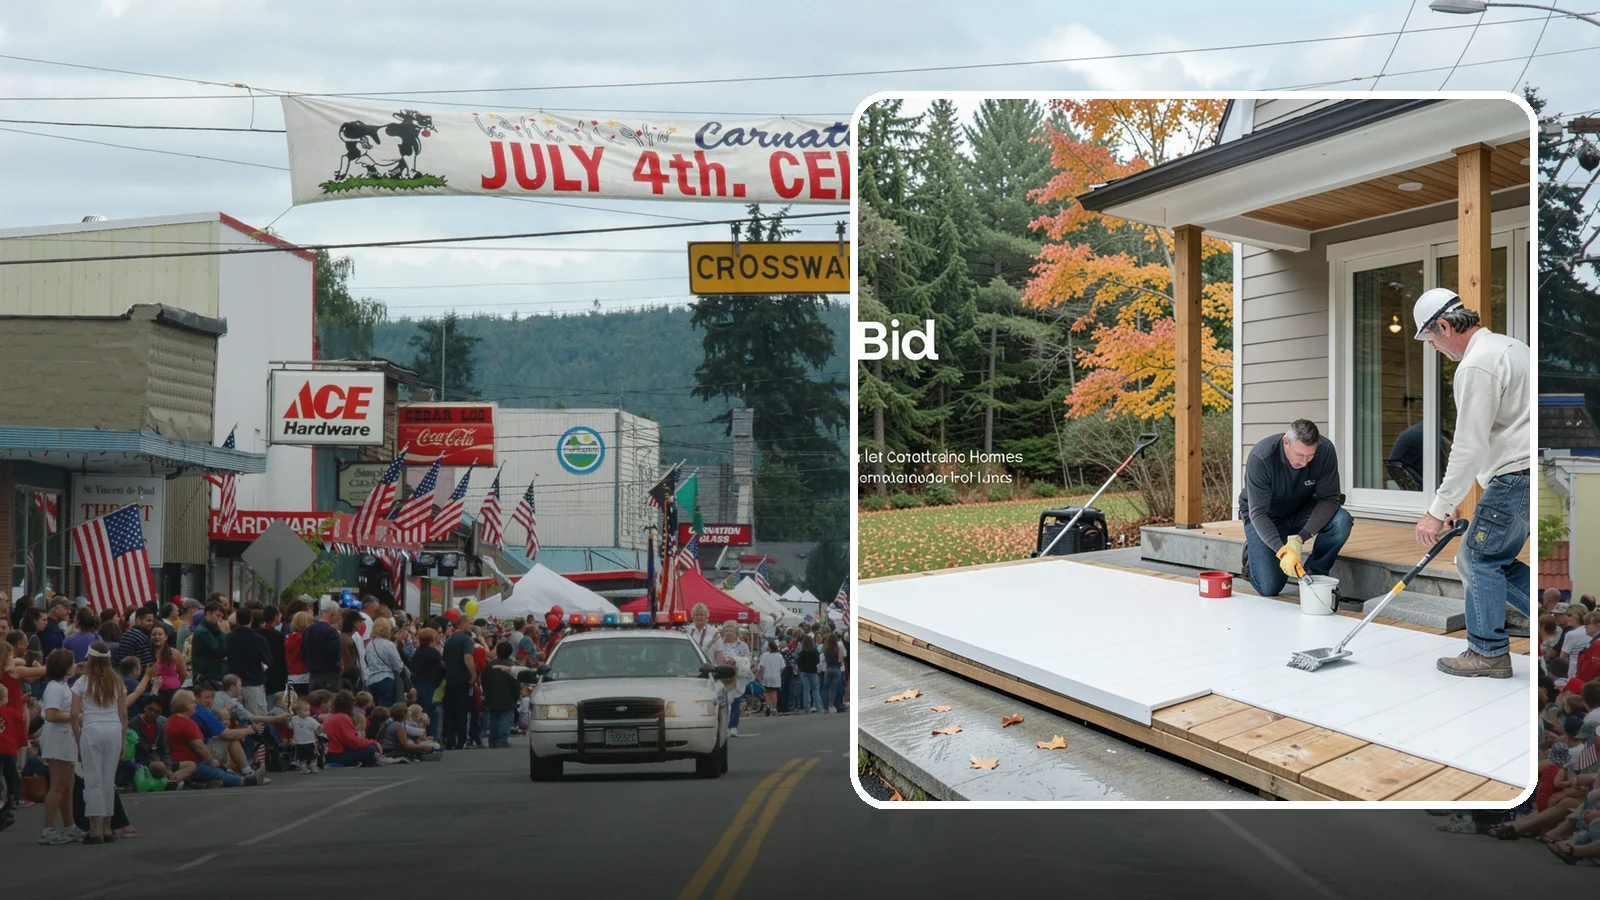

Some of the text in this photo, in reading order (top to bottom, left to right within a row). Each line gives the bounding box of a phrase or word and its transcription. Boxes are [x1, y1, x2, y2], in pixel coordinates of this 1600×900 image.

[481, 141, 605, 192] JULY
[632, 150, 746, 197] 4th.
[697, 254, 850, 280] CROSSWA
[283, 380, 373, 420] ACE
[405, 408, 485, 422] CEDAR LOG
[283, 421, 370, 436] Hardware
[416, 427, 477, 447] Coca-Cola
[95, 485, 124, 494] Vincent
[126, 486, 136, 494] de
[137, 486, 155, 495] Paul
[687, 526, 741, 535] CRNATION
[699, 535, 730, 543] GLASS
